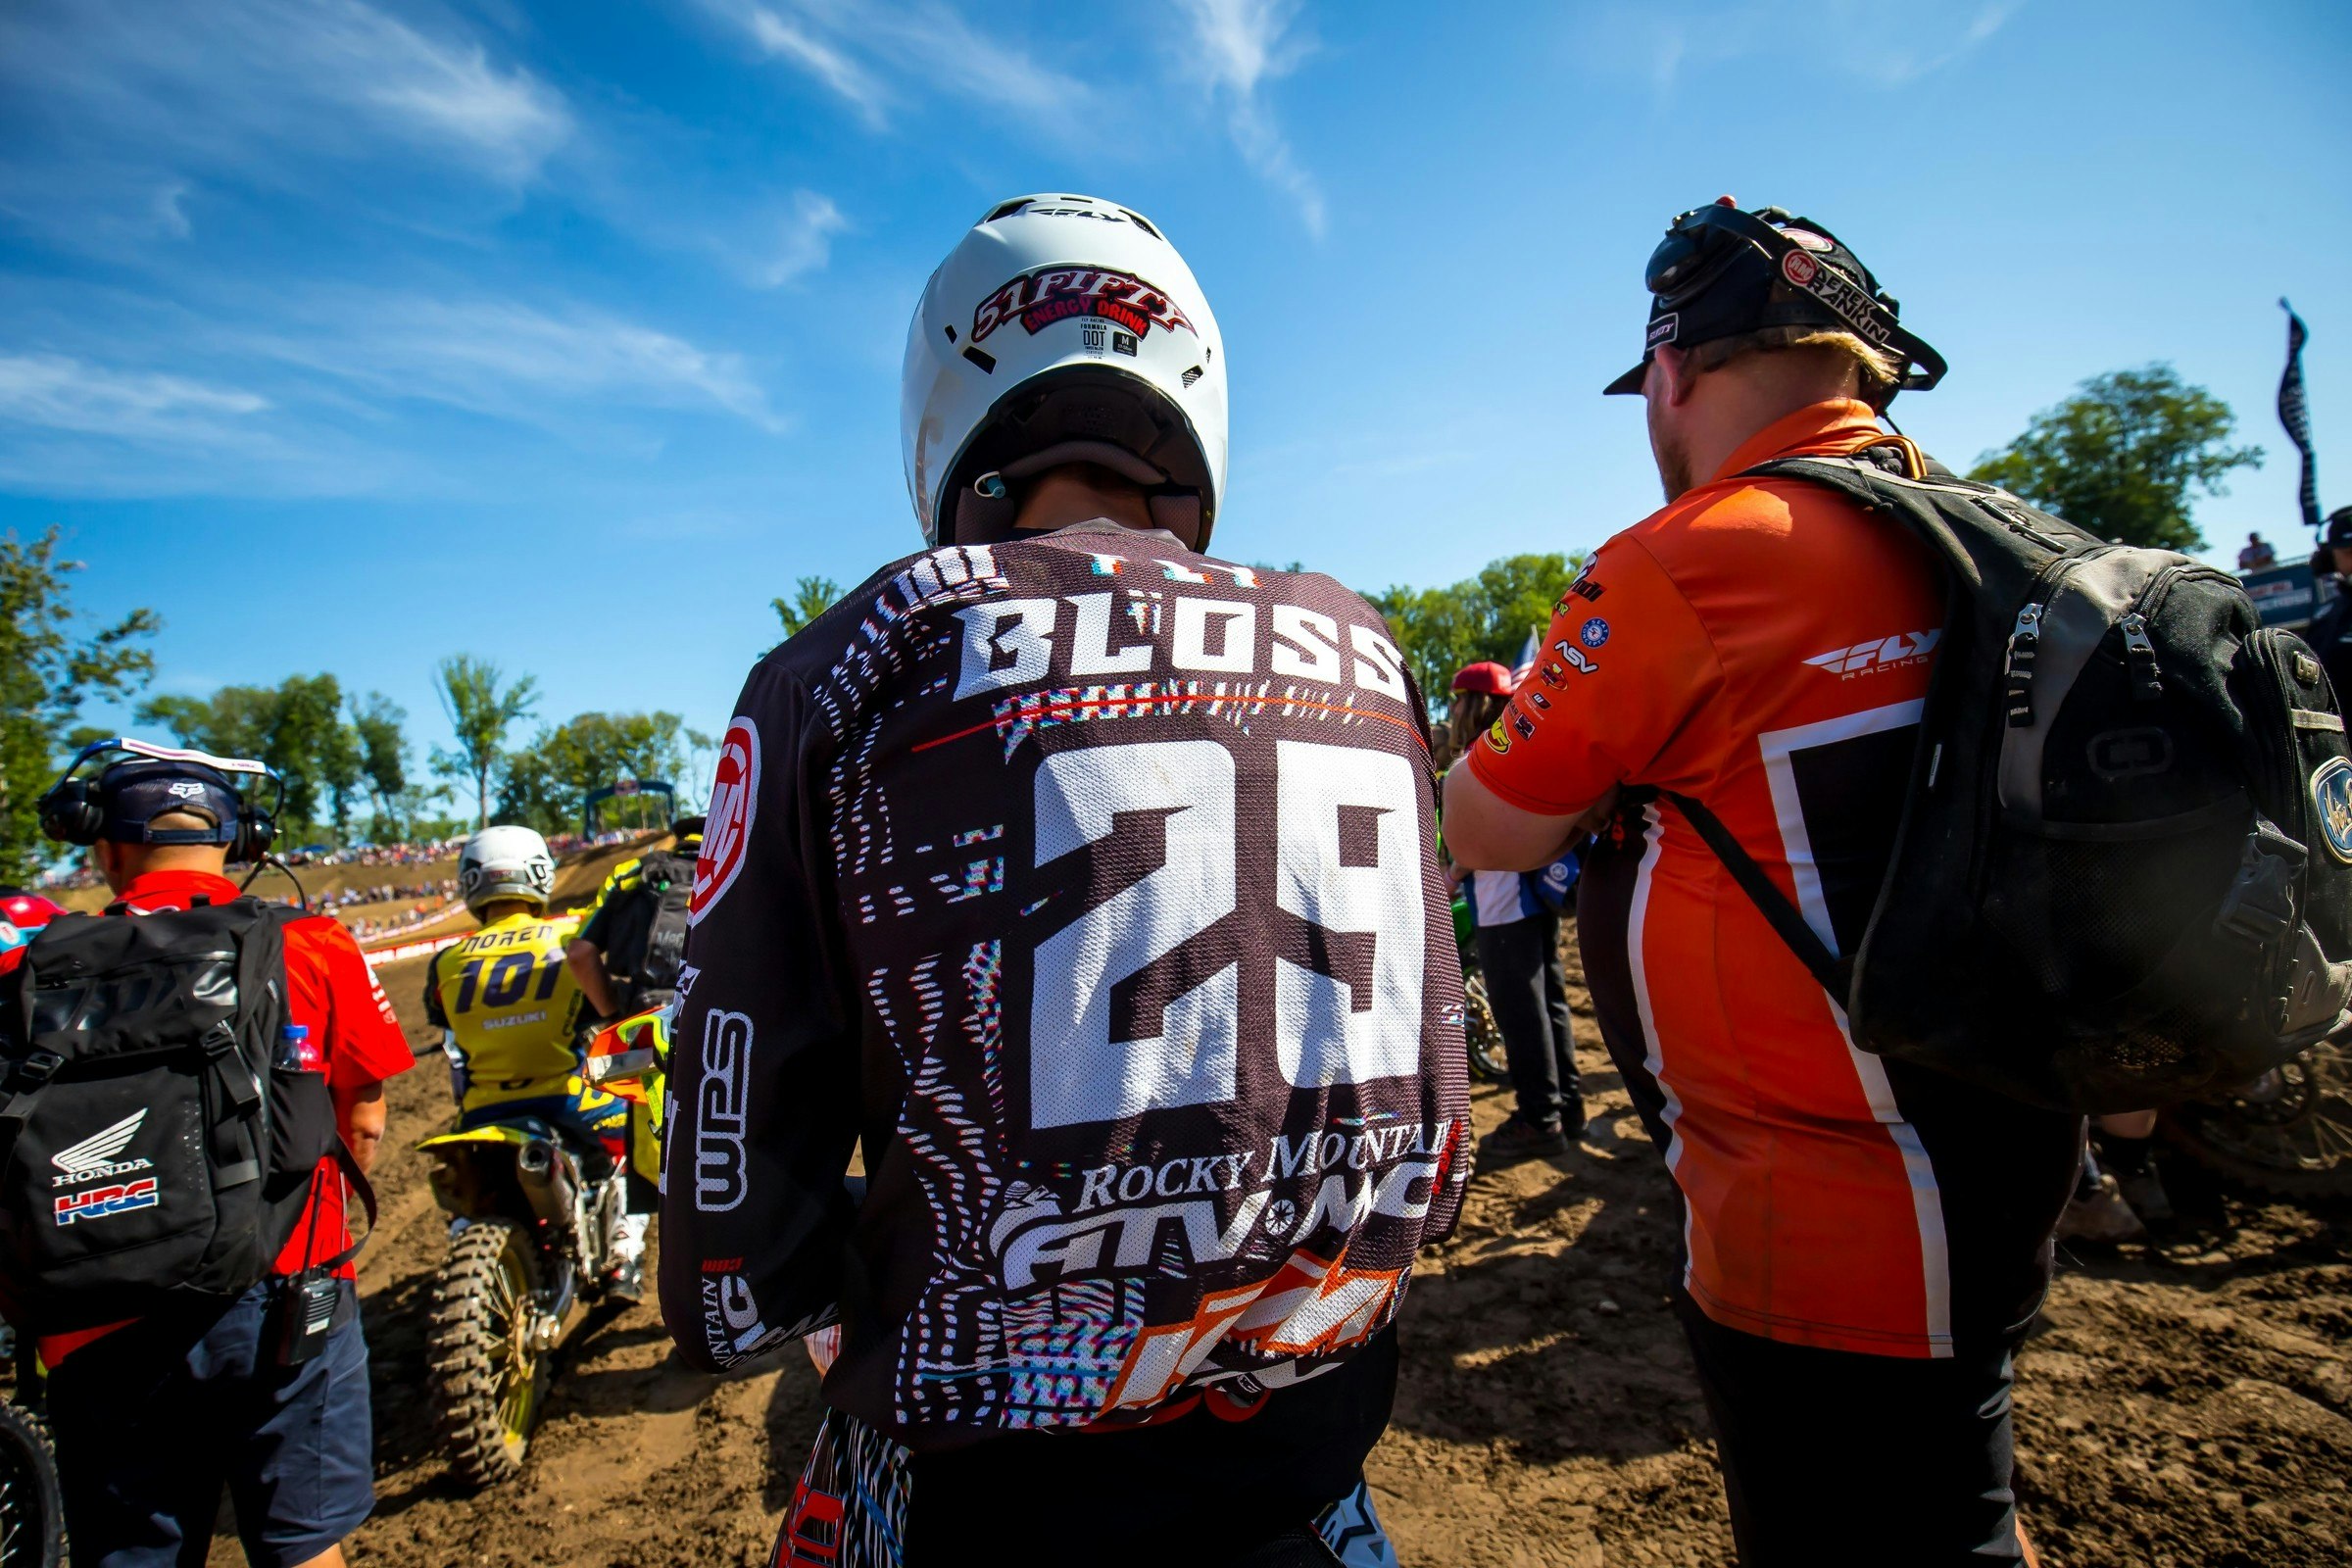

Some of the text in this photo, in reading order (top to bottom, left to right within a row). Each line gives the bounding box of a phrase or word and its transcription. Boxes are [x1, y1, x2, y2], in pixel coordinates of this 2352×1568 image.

[1806, 279, 1888, 343] RANKIN
[1814, 268, 1878, 319] DEREK
[1025, 294, 1148, 337] ENERGY DRINK
[1080, 322, 1107, 331] FORMULA
[1083, 329, 1105, 347] DOT
[1121, 335, 1130, 346] M
[952, 590, 1408, 702] BLOSS
[1582, 624, 1608, 647] CONCEPTS
[1591, 618, 1609, 634] SEAT
[1801, 628, 1943, 674] FLY
[1840, 655, 1929, 682] RACING
[461, 925, 553, 954] NOREN
[1030, 740, 1426, 1130] 29
[455, 951, 563, 1014] 101
[482, 1010, 547, 1031] SUZUKI
[695, 1006, 755, 1214] WPS
[52, 1157, 155, 1188] HONDA
[1071, 1151, 1255, 1215] ROCKY
[54, 1176, 160, 1227] HRC
